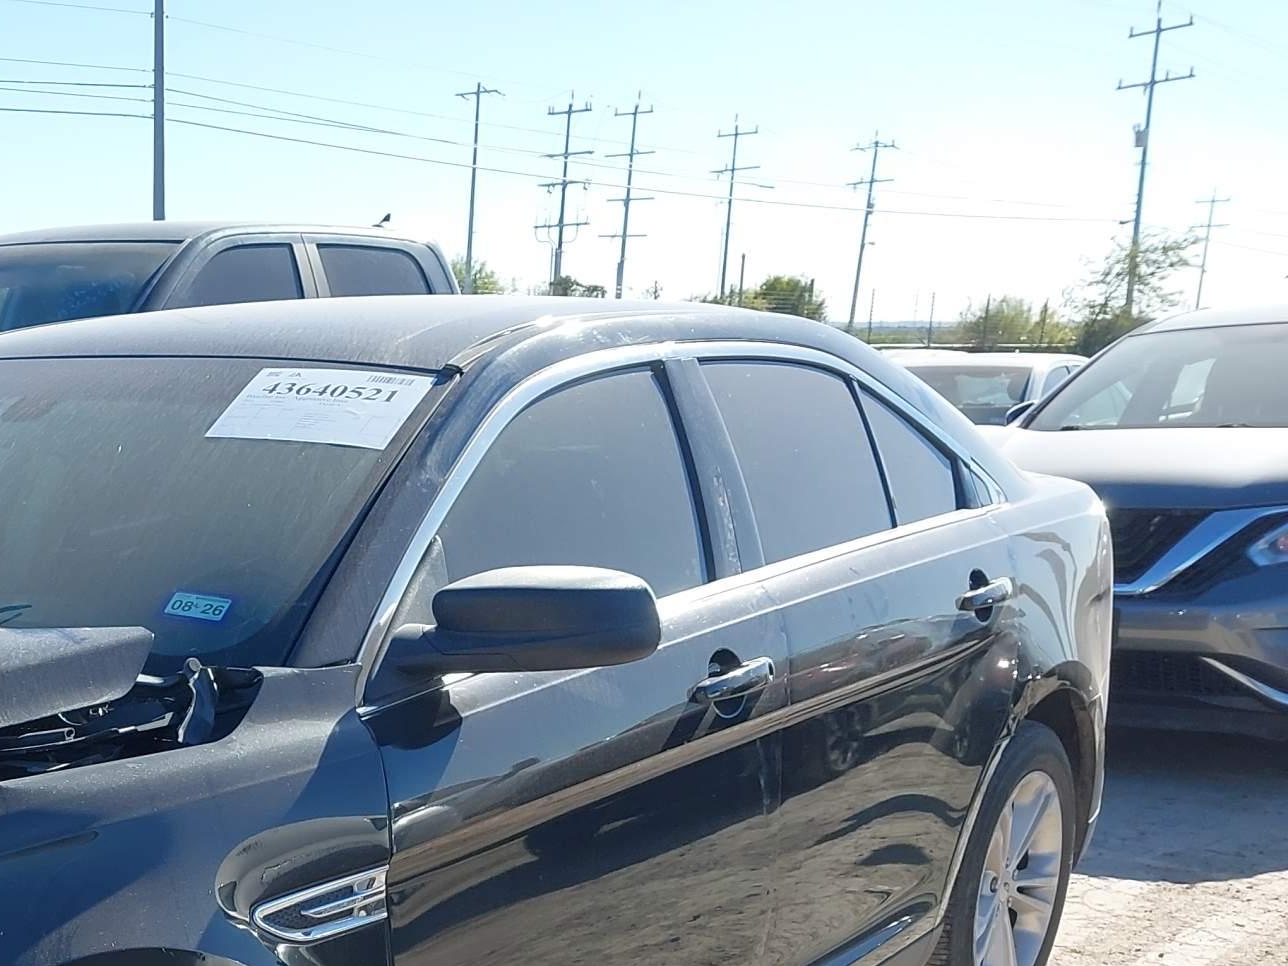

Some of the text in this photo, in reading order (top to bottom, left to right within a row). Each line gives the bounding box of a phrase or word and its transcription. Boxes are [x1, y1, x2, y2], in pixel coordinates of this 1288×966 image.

[262, 381, 400, 402] 43640521
[171, 600, 225, 616] 08 26
